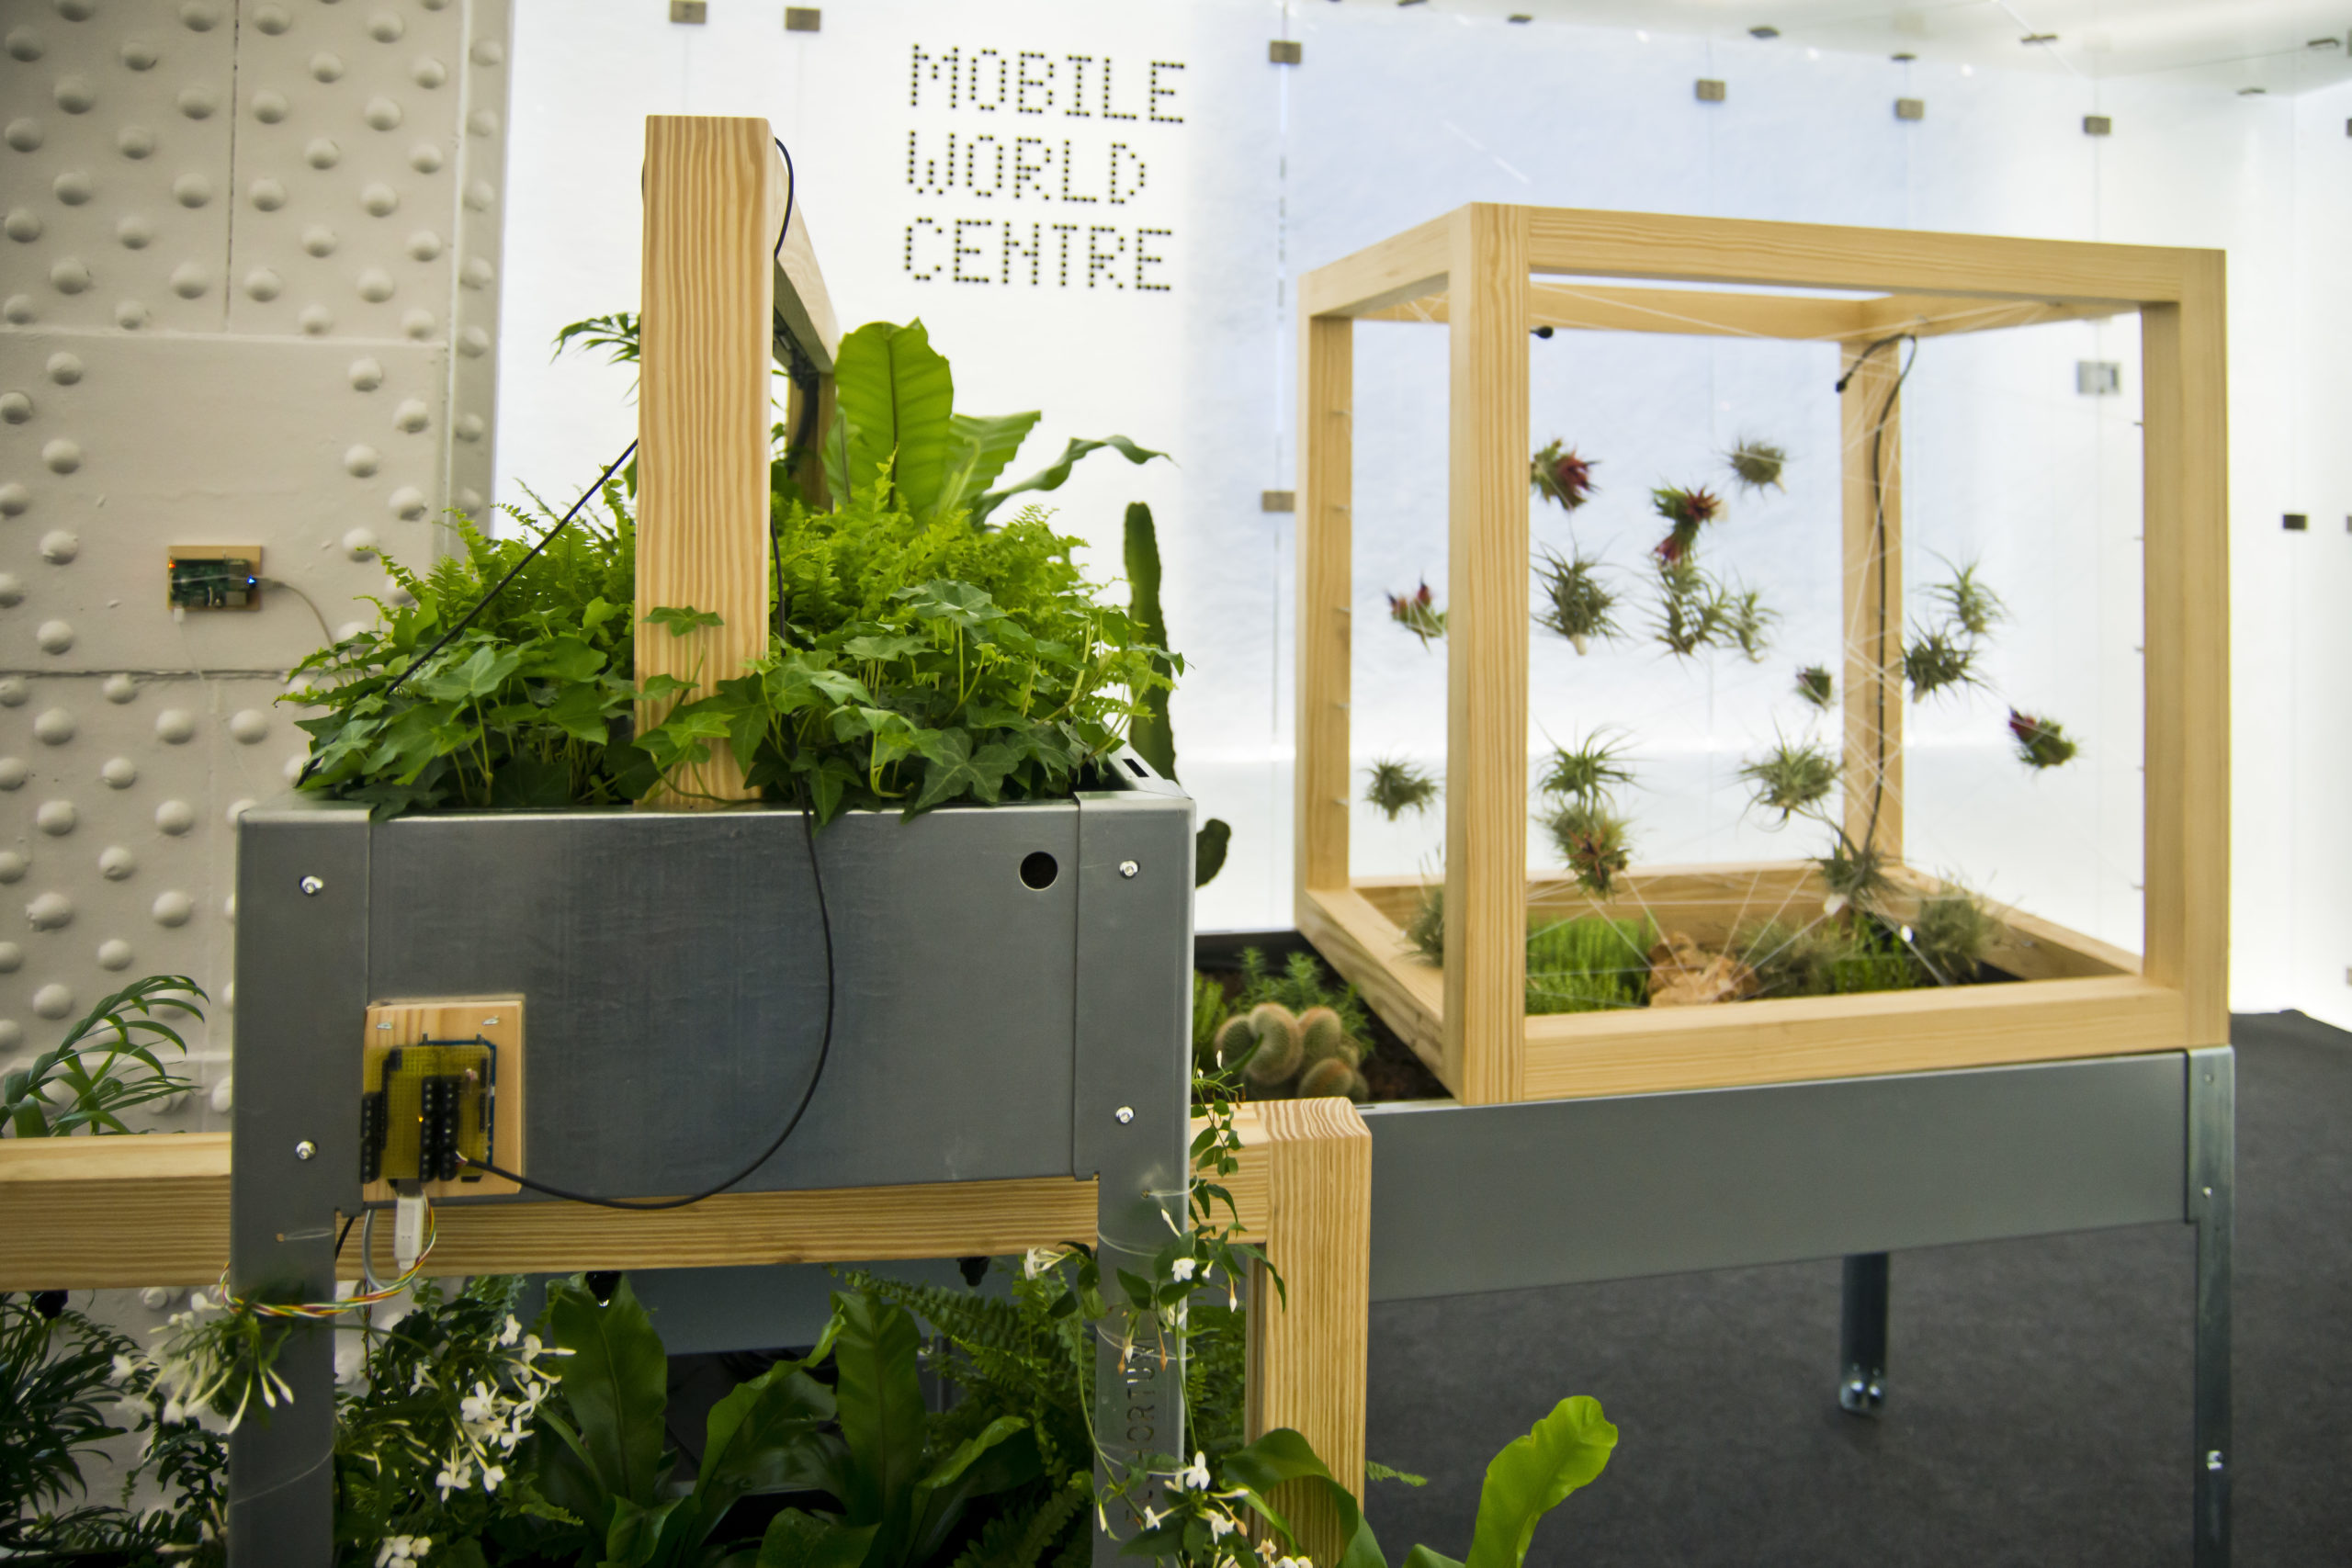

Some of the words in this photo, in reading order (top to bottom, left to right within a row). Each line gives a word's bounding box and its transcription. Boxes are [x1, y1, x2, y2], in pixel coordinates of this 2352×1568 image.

[911, 45, 1184, 123] MOBILE
[909, 131, 1145, 204] WORLD
[906, 219, 1171, 291] CENTRE
